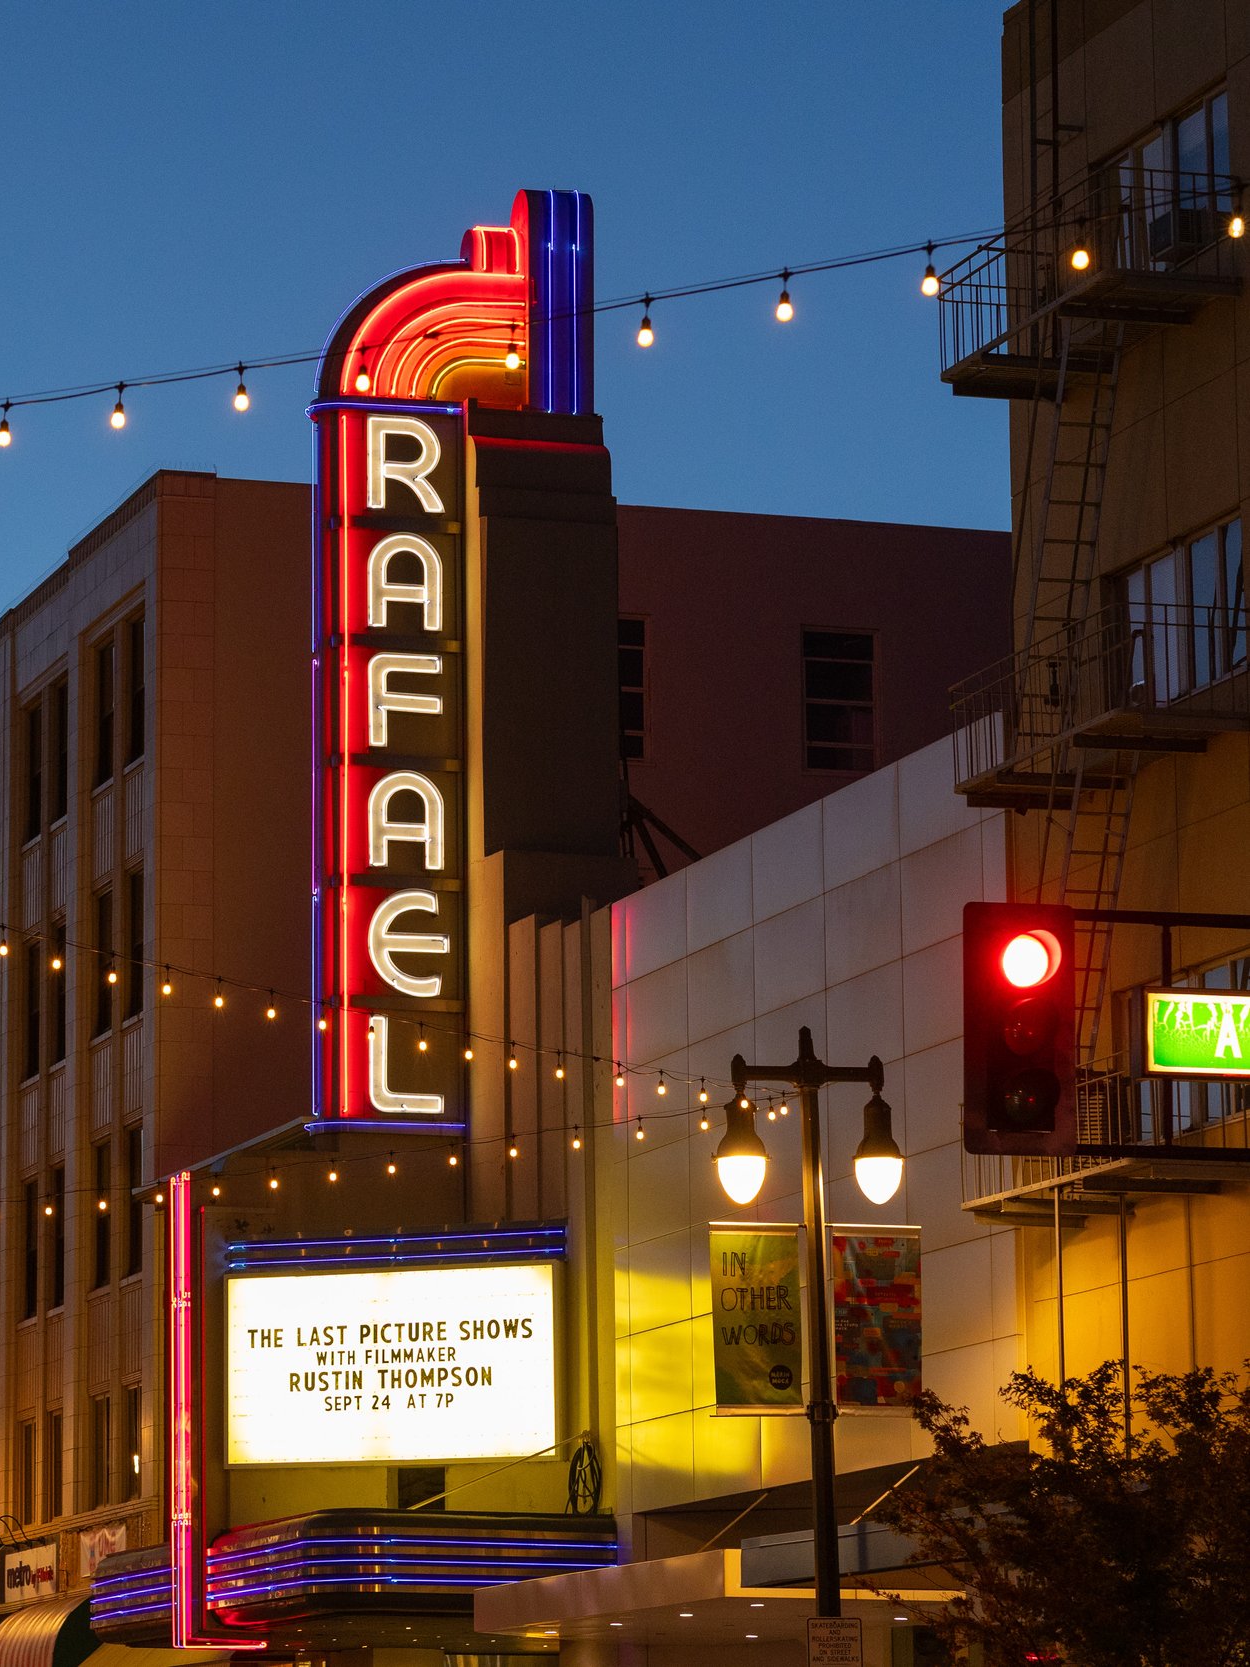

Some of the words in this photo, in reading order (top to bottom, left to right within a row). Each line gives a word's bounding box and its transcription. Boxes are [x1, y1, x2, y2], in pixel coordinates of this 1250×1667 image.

[365, 414, 450, 1115] RAFAEL
[722, 1252, 747, 1276] IN
[720, 1286, 792, 1311] OTHER
[248, 1328, 284, 1349] THE
[297, 1325, 348, 1346] LAST
[359, 1321, 447, 1345] PICTURE
[459, 1318, 533, 1341] SHOWS
[722, 1322, 796, 1346] WORDS
[316, 1350, 356, 1367] WITH
[365, 1347, 456, 1364] FILMMAKER
[289, 1370, 363, 1392] RUSTIN
[378, 1366, 492, 1390] THOMPSON
[325, 1396, 363, 1411] SEPT
[372, 1395, 391, 1411] 24
[407, 1394, 427, 1409] AT
[436, 1393, 454, 1408] 7P
[7, 1560, 31, 1589] metro
